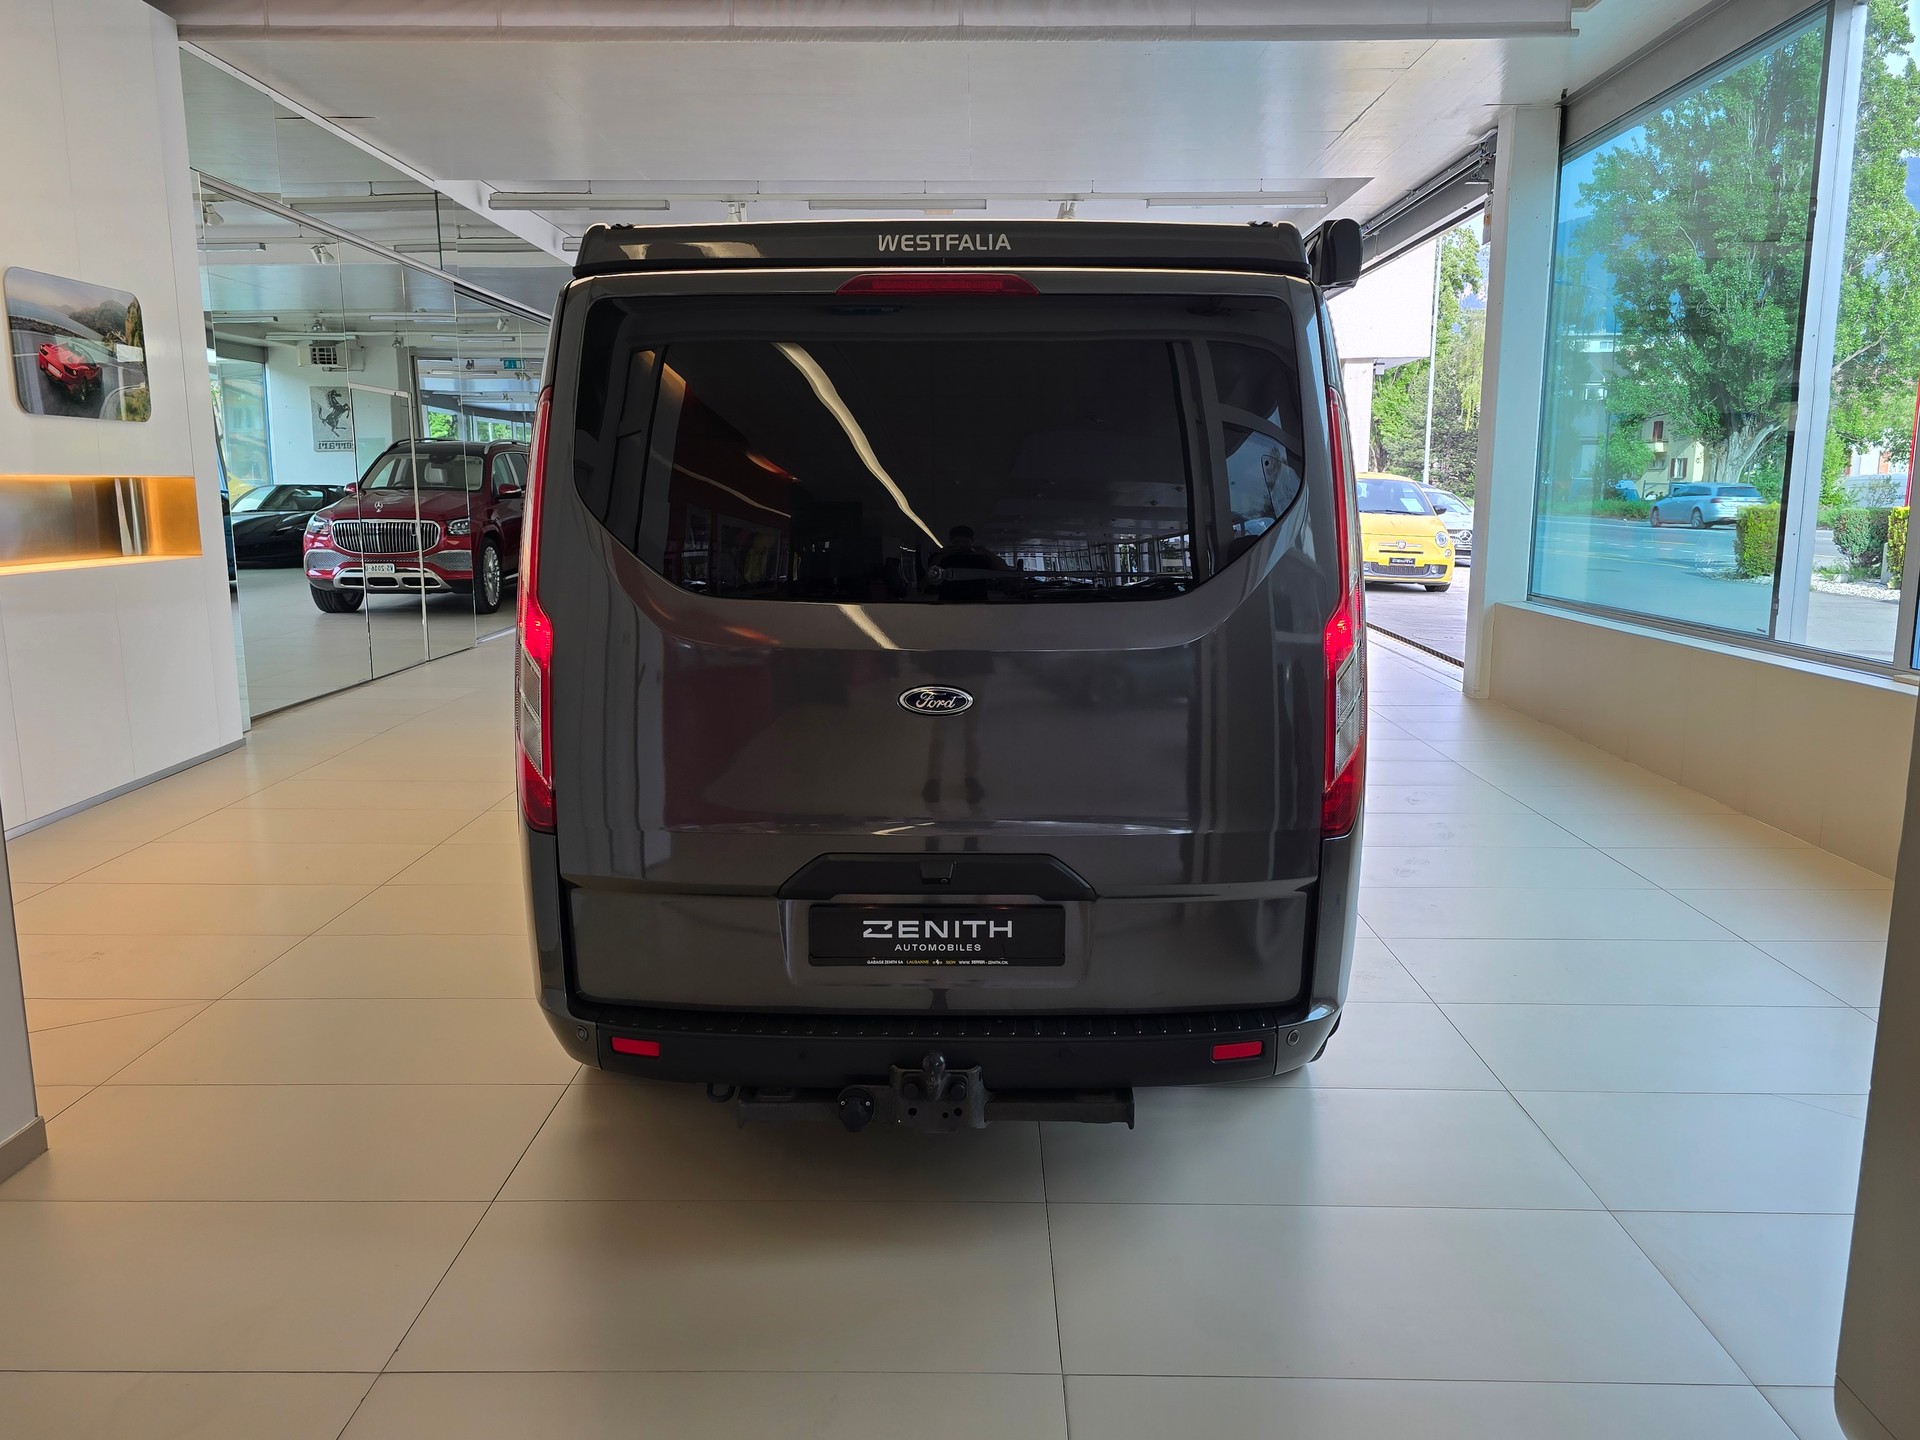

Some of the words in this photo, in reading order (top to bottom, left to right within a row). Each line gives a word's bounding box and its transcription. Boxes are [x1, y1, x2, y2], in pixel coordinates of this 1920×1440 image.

[878, 233, 1012, 251] WESTFALIA
[915, 690, 963, 709] Ford
[863, 920, 1013, 938] ZENITH
[894, 943, 982, 952] AUTOMOBILES
